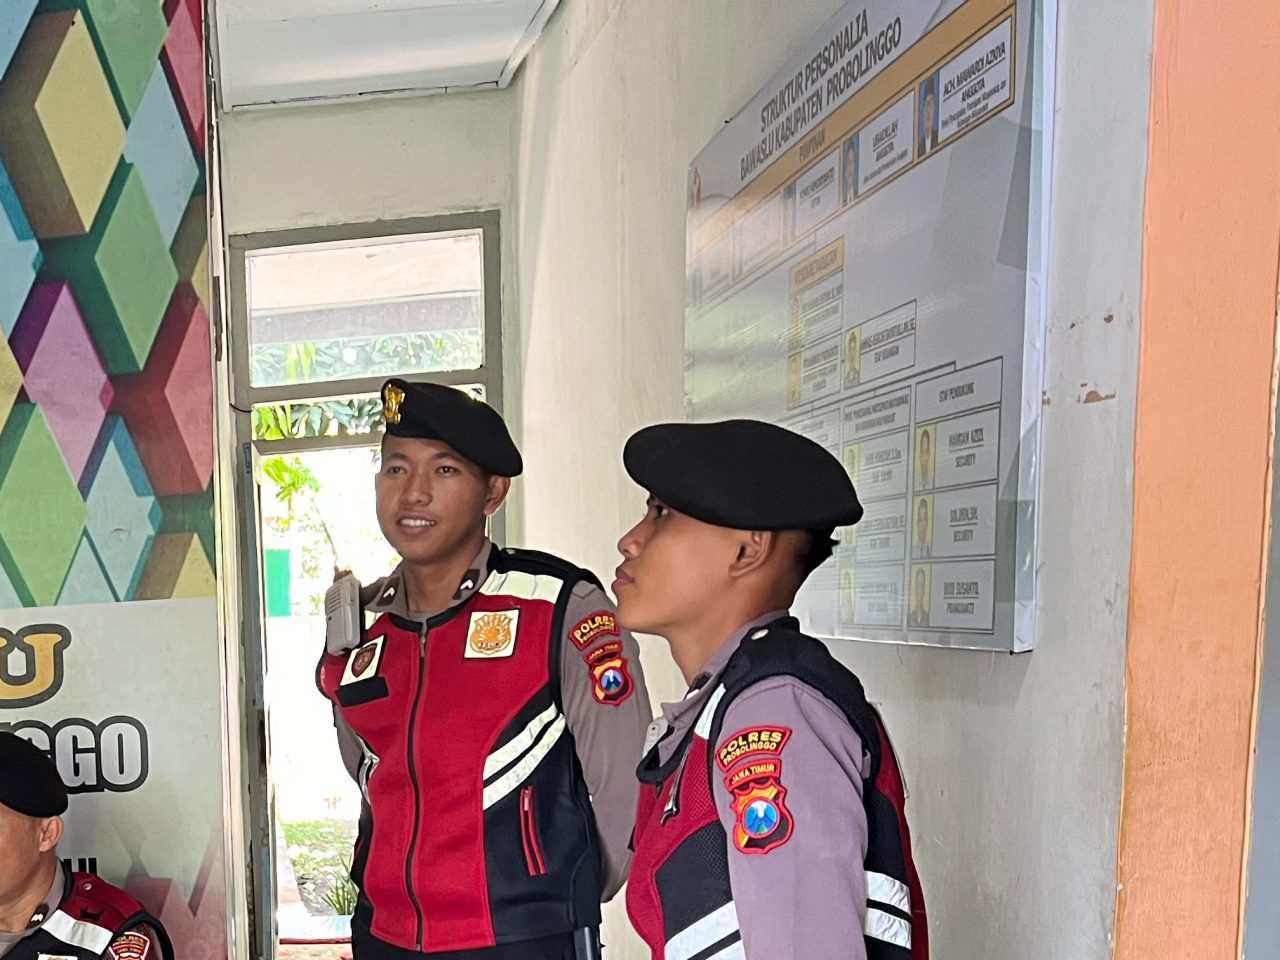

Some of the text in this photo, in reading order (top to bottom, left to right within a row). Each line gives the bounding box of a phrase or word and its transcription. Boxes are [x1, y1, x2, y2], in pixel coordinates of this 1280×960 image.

[761, 9, 869, 132] STRUKTUR PERSONALIA
[774, 87, 824, 152] KABUPATEN
[826, 16, 902, 106] PROBOLINGGO
[720, 731, 783, 760] POLRES
[750, 764, 775, 776] TIMUR
